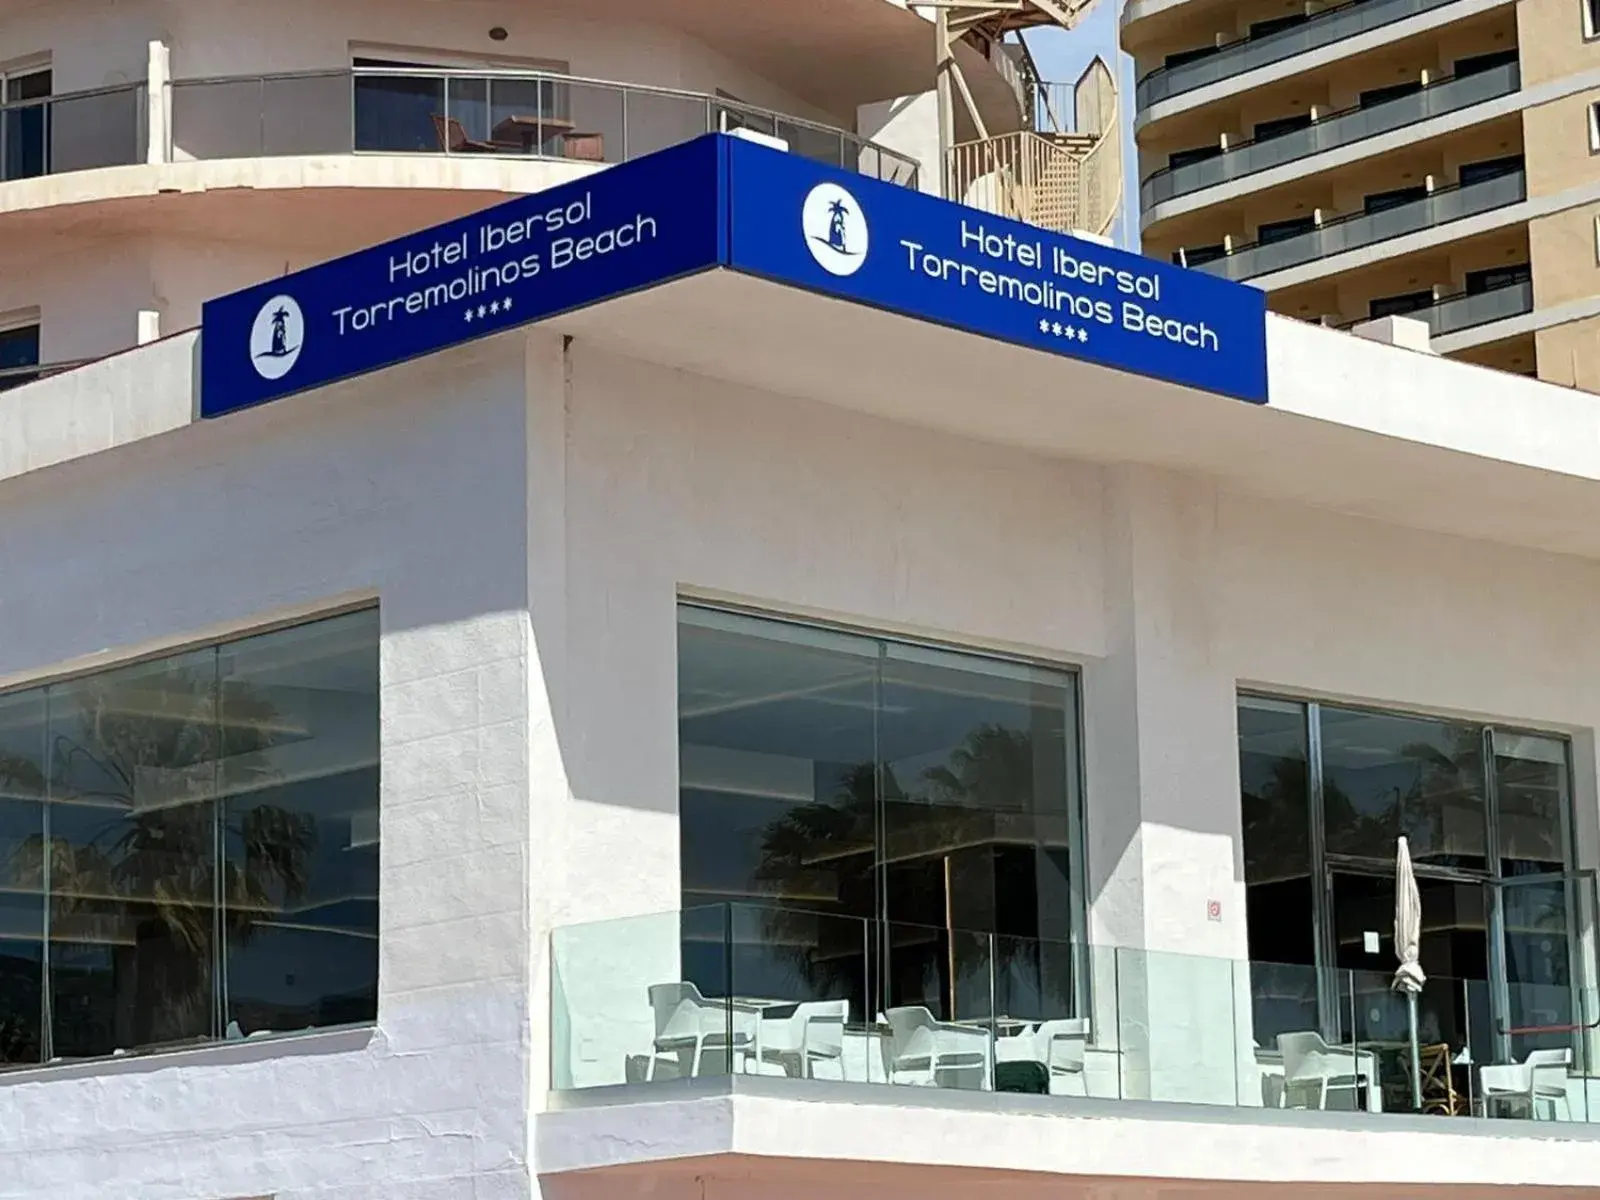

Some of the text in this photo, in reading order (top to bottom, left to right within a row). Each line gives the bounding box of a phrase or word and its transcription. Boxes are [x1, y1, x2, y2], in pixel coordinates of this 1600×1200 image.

[332, 214, 657, 335] Torremolinos Beach
[389, 191, 591, 283] Hotel Ibersol
[960, 220, 1160, 301] Hotel Ibersol
[900, 239, 1220, 352] Torremolinos Beach
